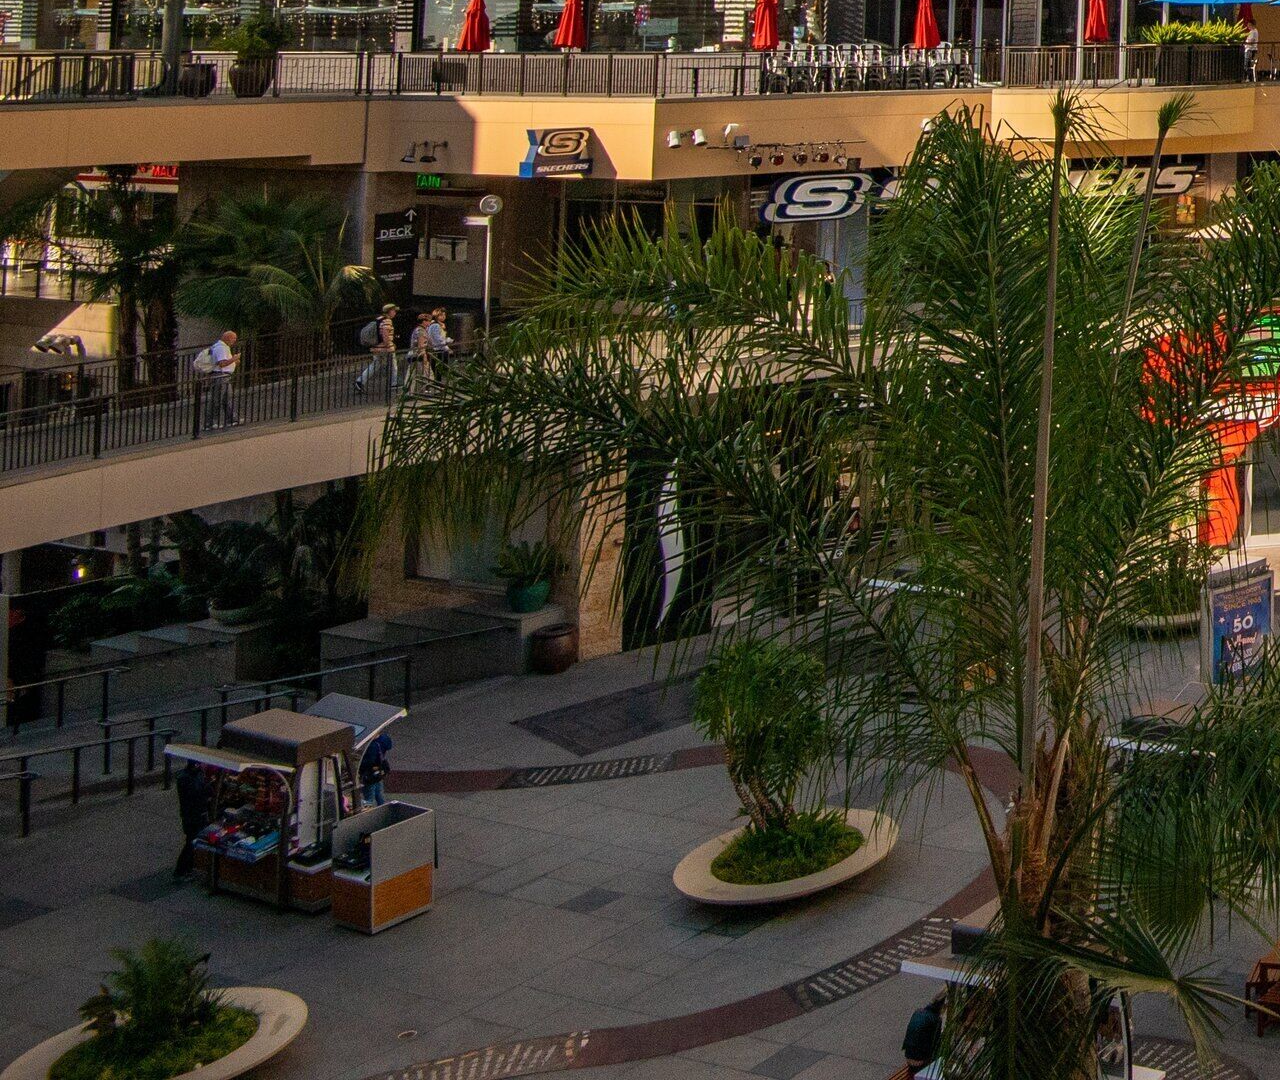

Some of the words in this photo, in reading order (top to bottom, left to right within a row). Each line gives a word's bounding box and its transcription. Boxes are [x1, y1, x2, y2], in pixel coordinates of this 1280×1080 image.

[536, 163, 589, 173] SKECHERS
[486, 198, 498, 212] 3
[380, 224, 414, 238] DECK
[1233, 615, 1254, 633] 50
